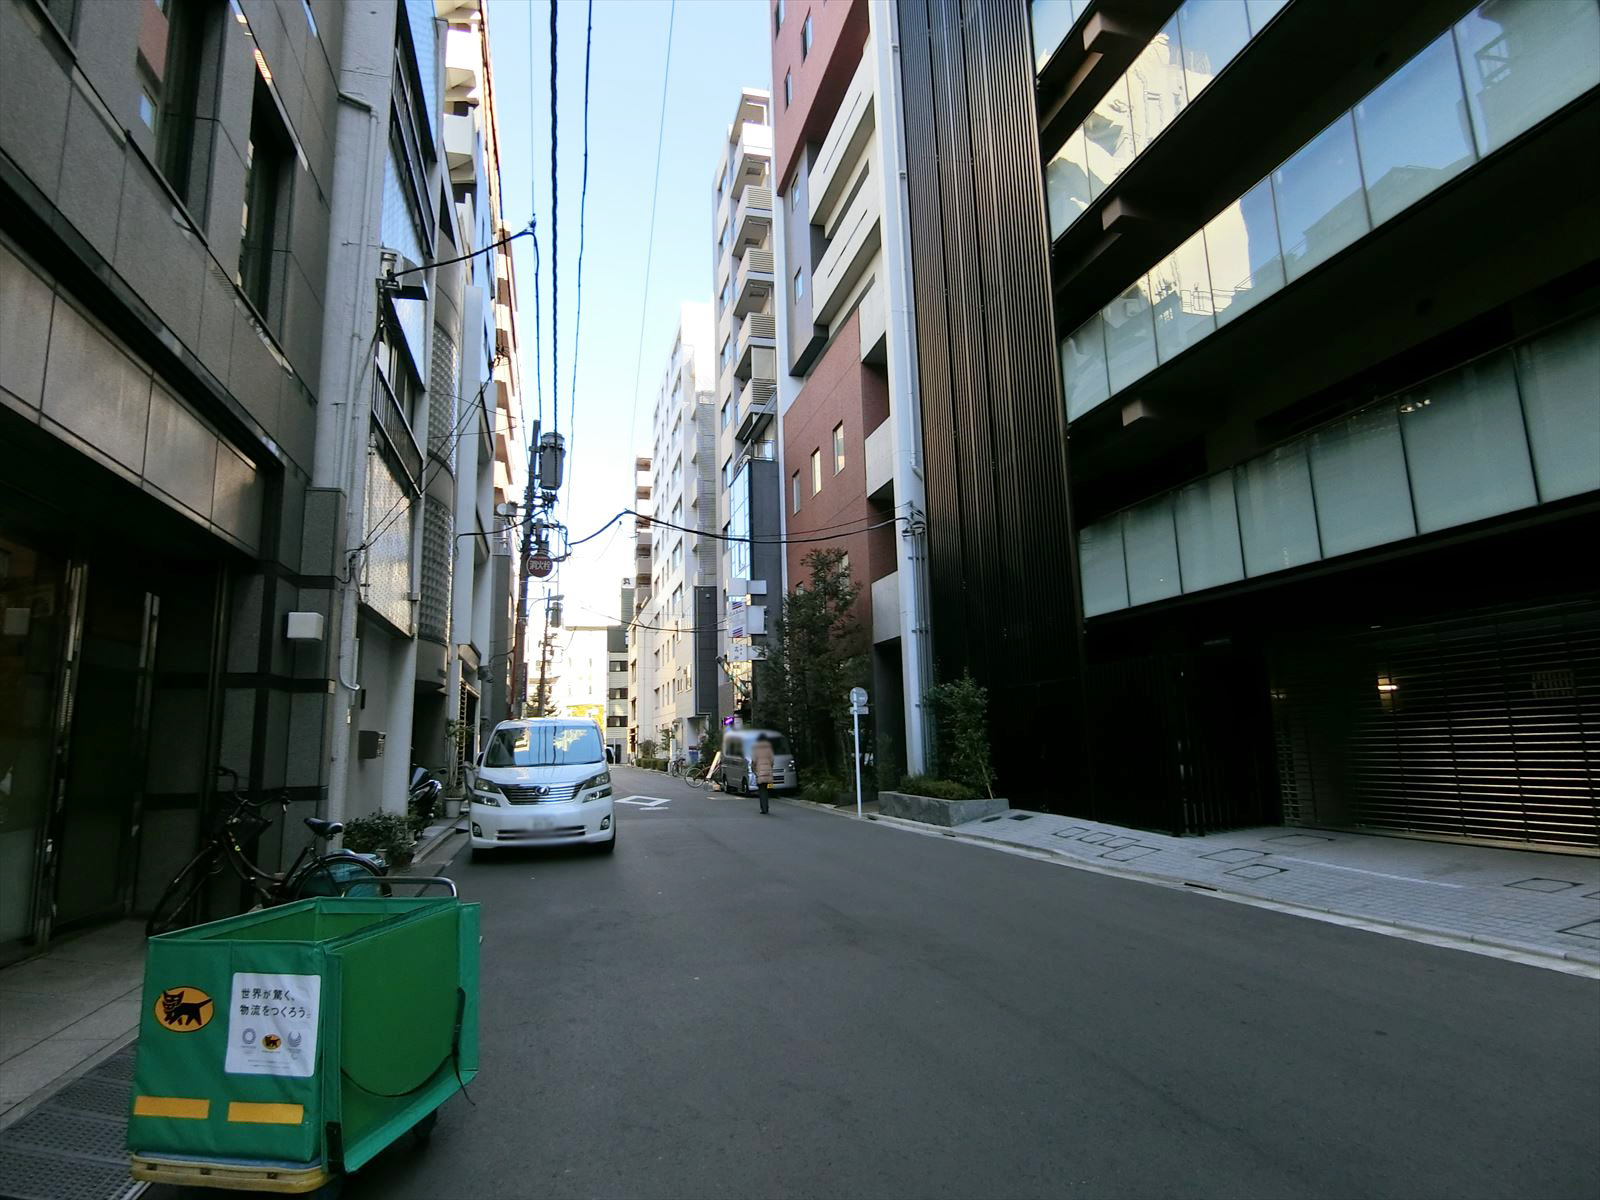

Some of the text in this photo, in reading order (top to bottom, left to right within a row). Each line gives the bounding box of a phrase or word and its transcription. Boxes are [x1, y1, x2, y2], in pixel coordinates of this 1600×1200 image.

[529, 560, 551, 571] 消火栓
[241, 988, 295, 1001] 世界が驚く、
